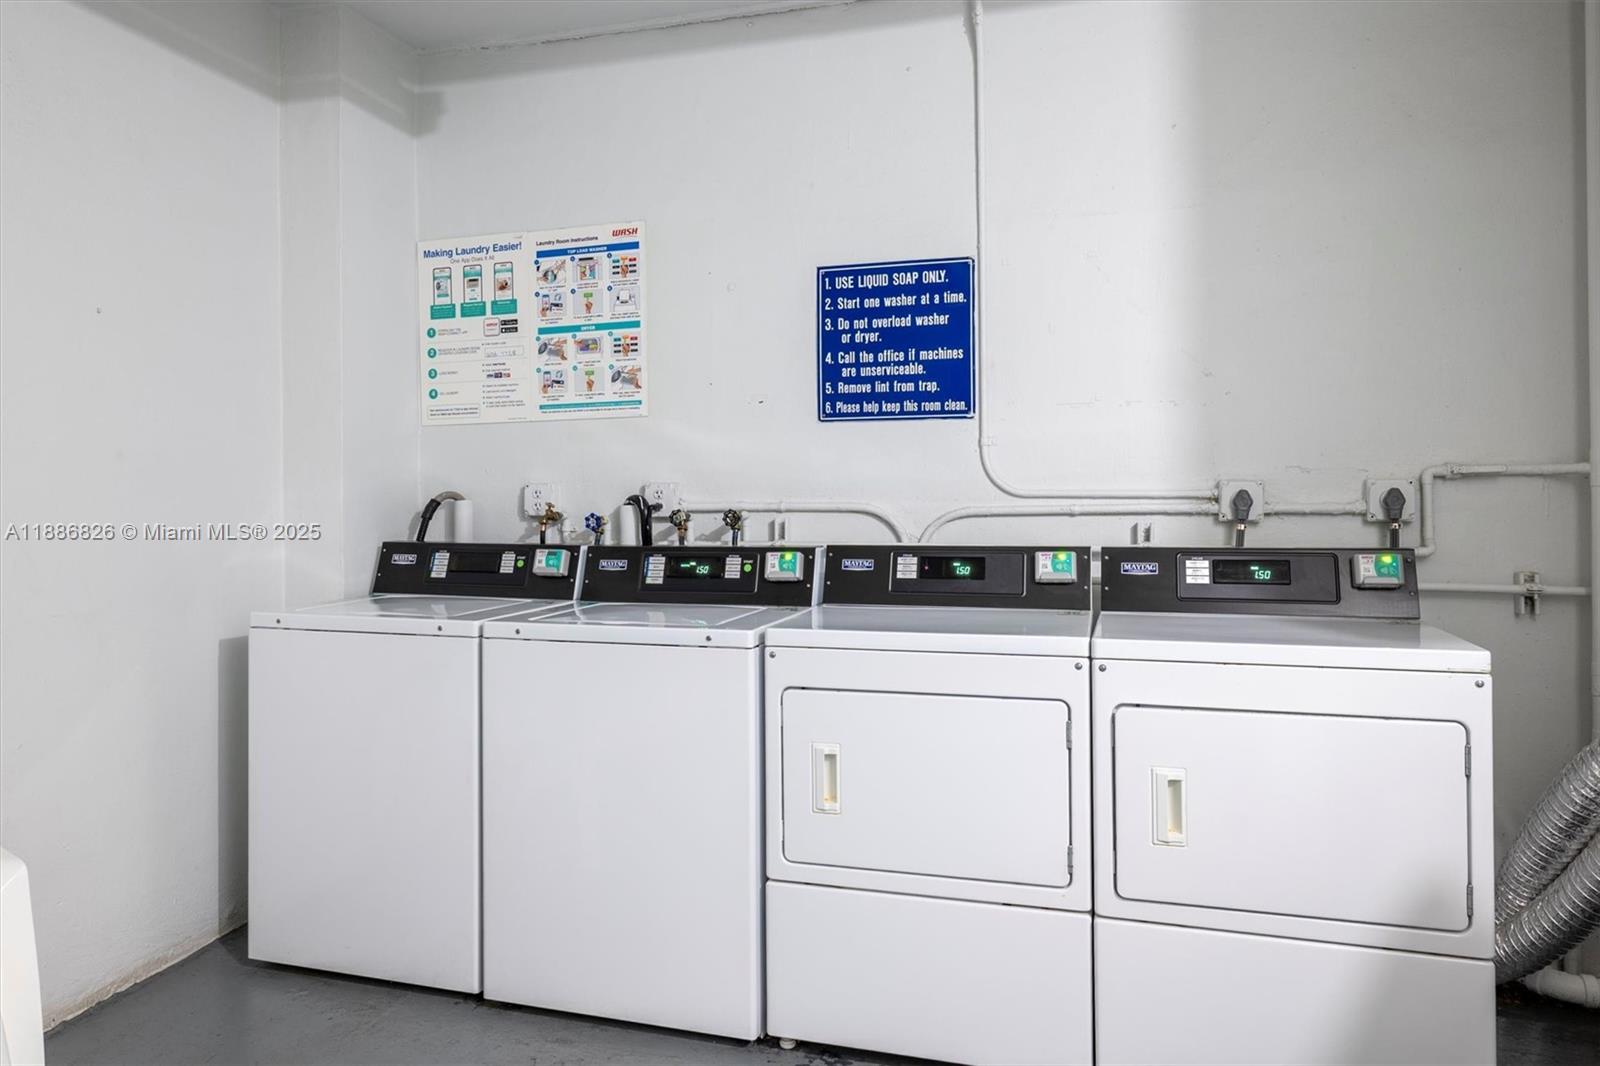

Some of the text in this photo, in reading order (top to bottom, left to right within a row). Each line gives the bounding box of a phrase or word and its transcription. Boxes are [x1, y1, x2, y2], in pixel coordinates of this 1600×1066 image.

[612, 227, 638, 237] WASH
[423, 242, 522, 258] Making Laundry Easier!
[825, 270, 949, 290] 1. USE LIQUID SOAP ONLY.
[825, 291, 966, 310] 2. Start one washer at a time.
[824, 314, 949, 330] 3. Do not overload washer
[841, 331, 882, 344] or dryer.
[825, 348, 963, 364] 4. Call the office if machines
[842, 364, 926, 377] are unserviceable.
[826, 381, 939, 394] 5. Remove lint from trap.
[826, 400, 967, 414] 6. Please help keep this room clean.
[393, 554, 416, 562] MAYTAG
[600, 560, 627, 568] MAYTAG
[1123, 563, 1157, 571] MAYTAG
